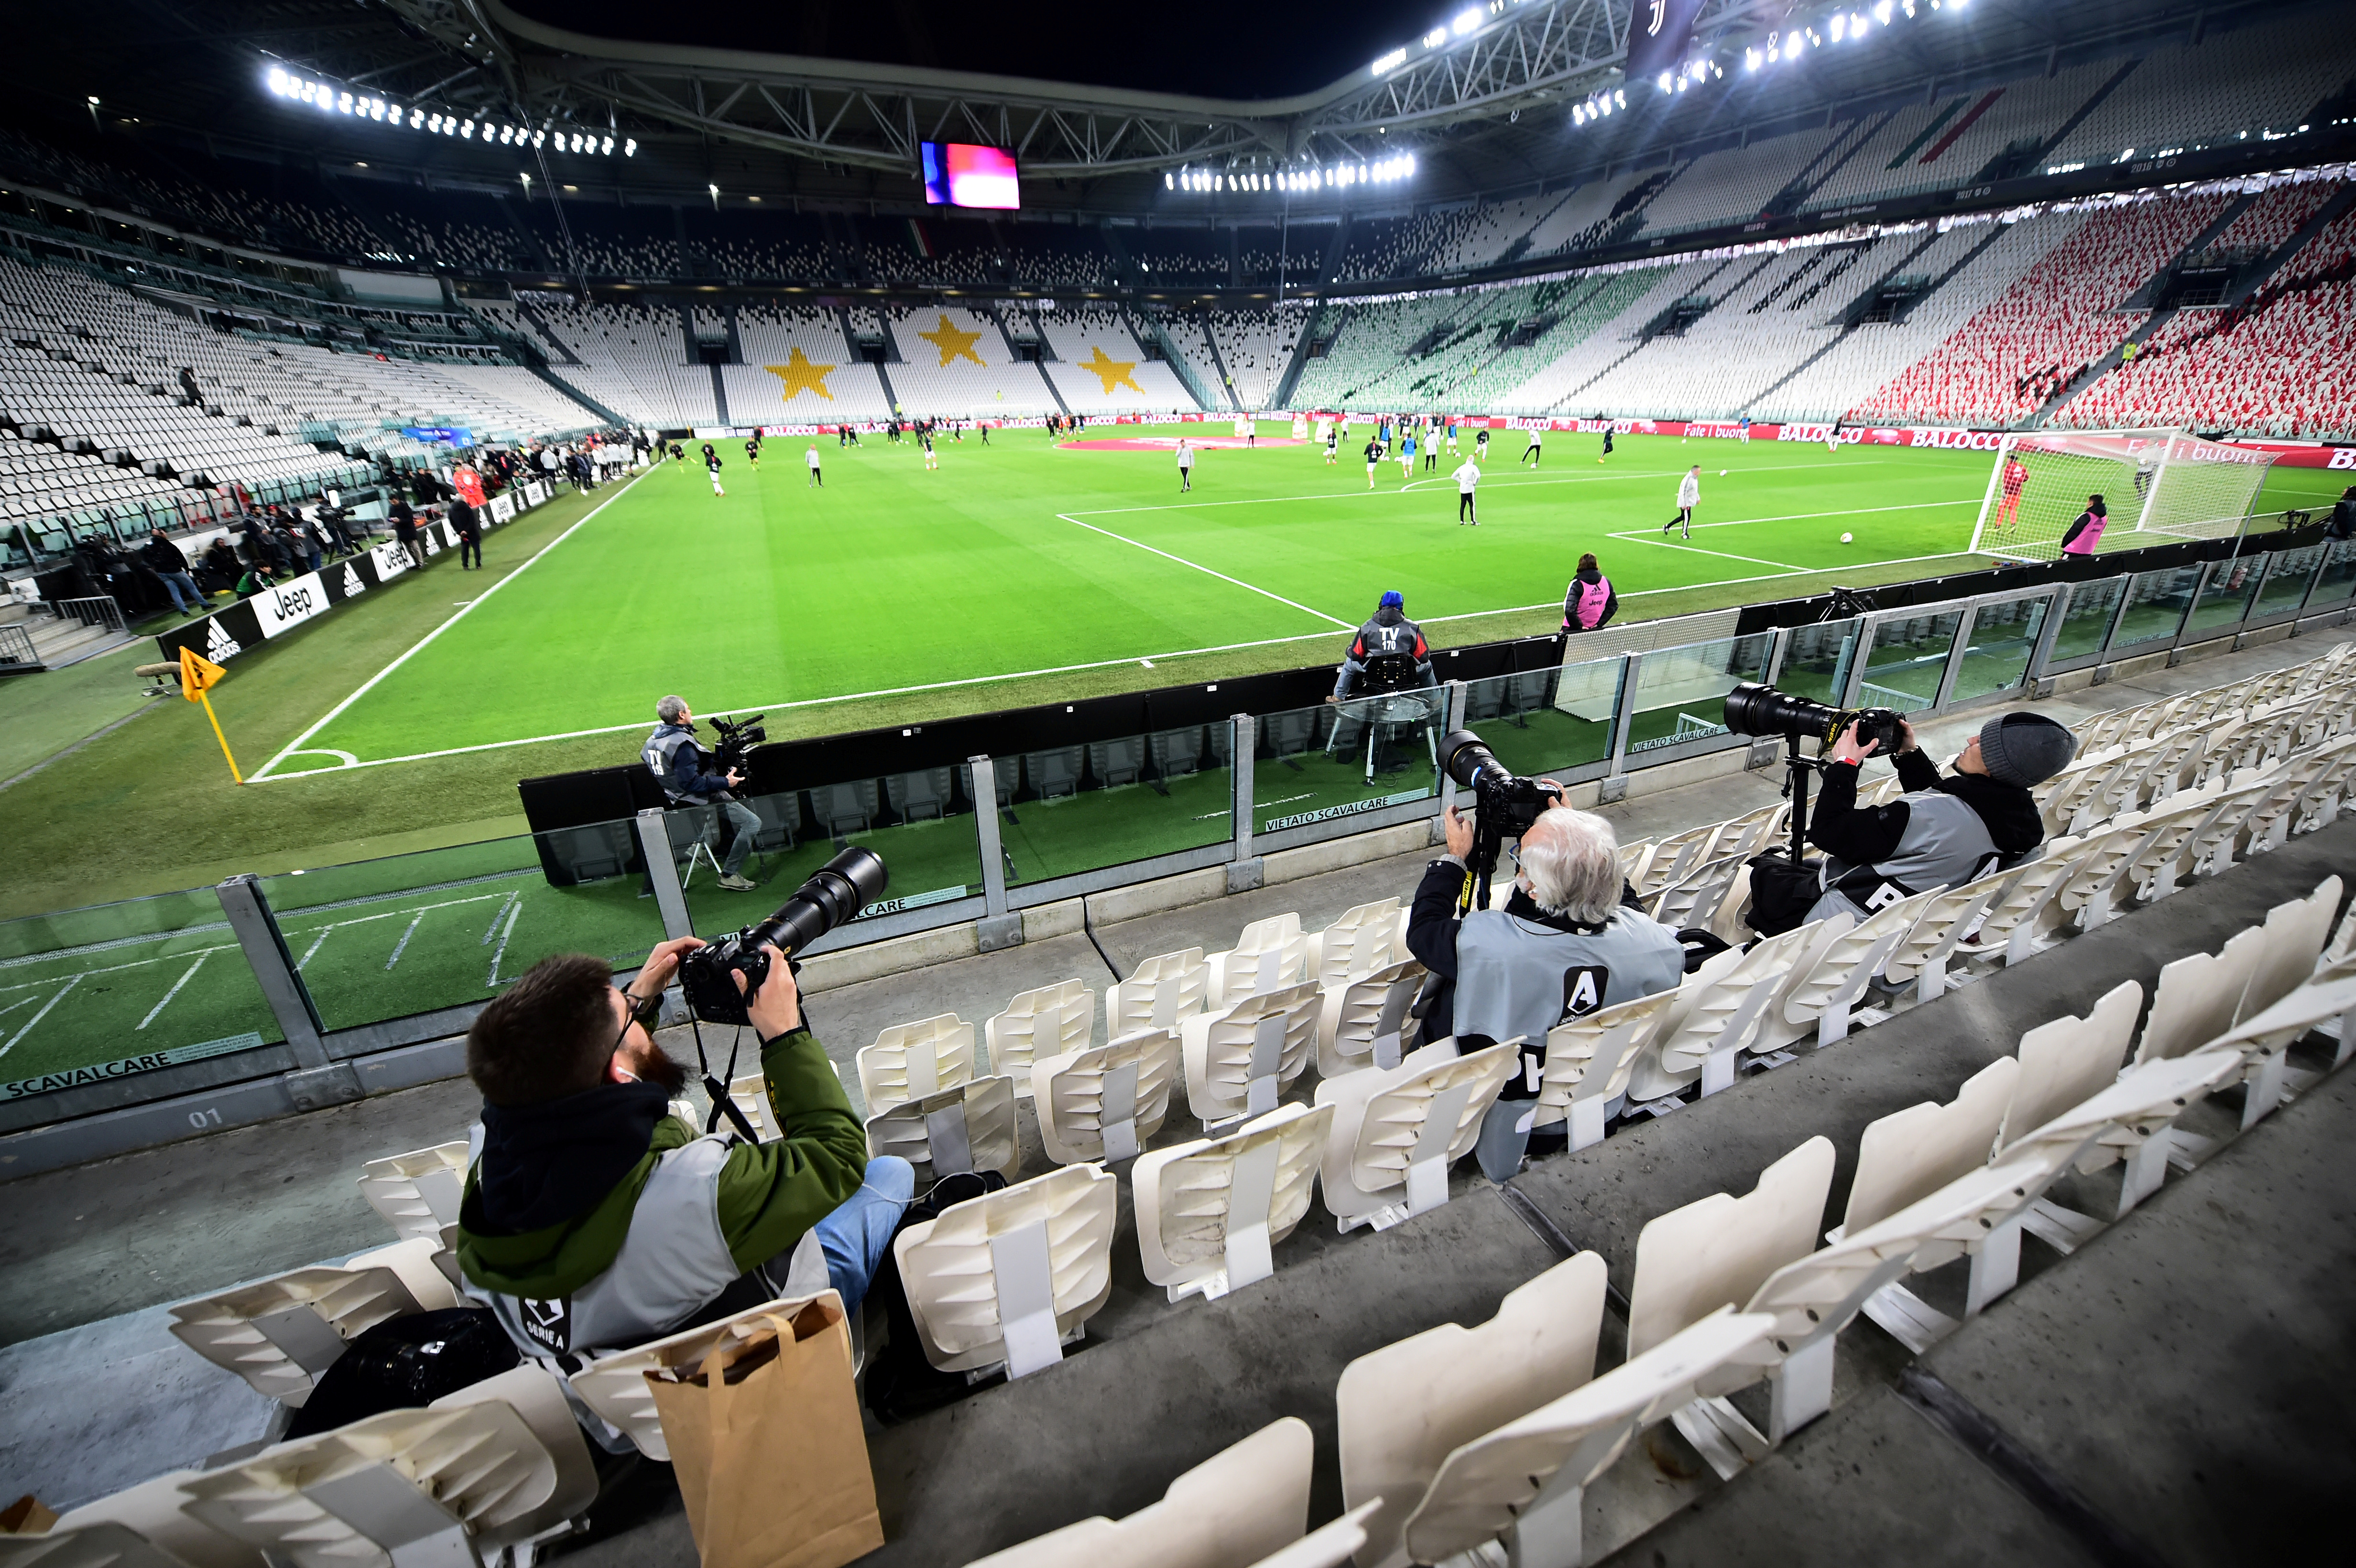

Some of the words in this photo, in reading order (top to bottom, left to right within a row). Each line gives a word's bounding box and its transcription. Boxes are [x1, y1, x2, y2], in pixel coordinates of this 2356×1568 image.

[1821, 210, 1841, 220] Allianz
[1851, 205, 1877, 215] Stadium
[763, 425, 818, 437] BALOCCO
[1505, 418, 1553, 431] BALOCCO
[1683, 423, 1705, 437] Fate
[384, 546, 408, 569] Jeep
[344, 580, 367, 598] adidas
[273, 586, 312, 621] Jeep
[1379, 627, 1400, 641] TV
[207, 640, 241, 664] adidas
[1382, 640, 1396, 650] 170
[1633, 738, 1667, 751] VIETATO
[1669, 726, 1719, 744] SCAVALCARE
[1828, 723, 1838, 743] Nikon
[647, 749, 661, 764] TV
[652, 763, 665, 775] 119
[1266, 812, 1314, 830] VIETATO
[1318, 796, 1388, 820] SCAVALCARE
[6, 1053, 172, 1098] SCAVALCARE
[187, 1108, 223, 1129] 01
[526, 1320, 555, 1345] SERIE
[556, 1334, 564, 1350] A
